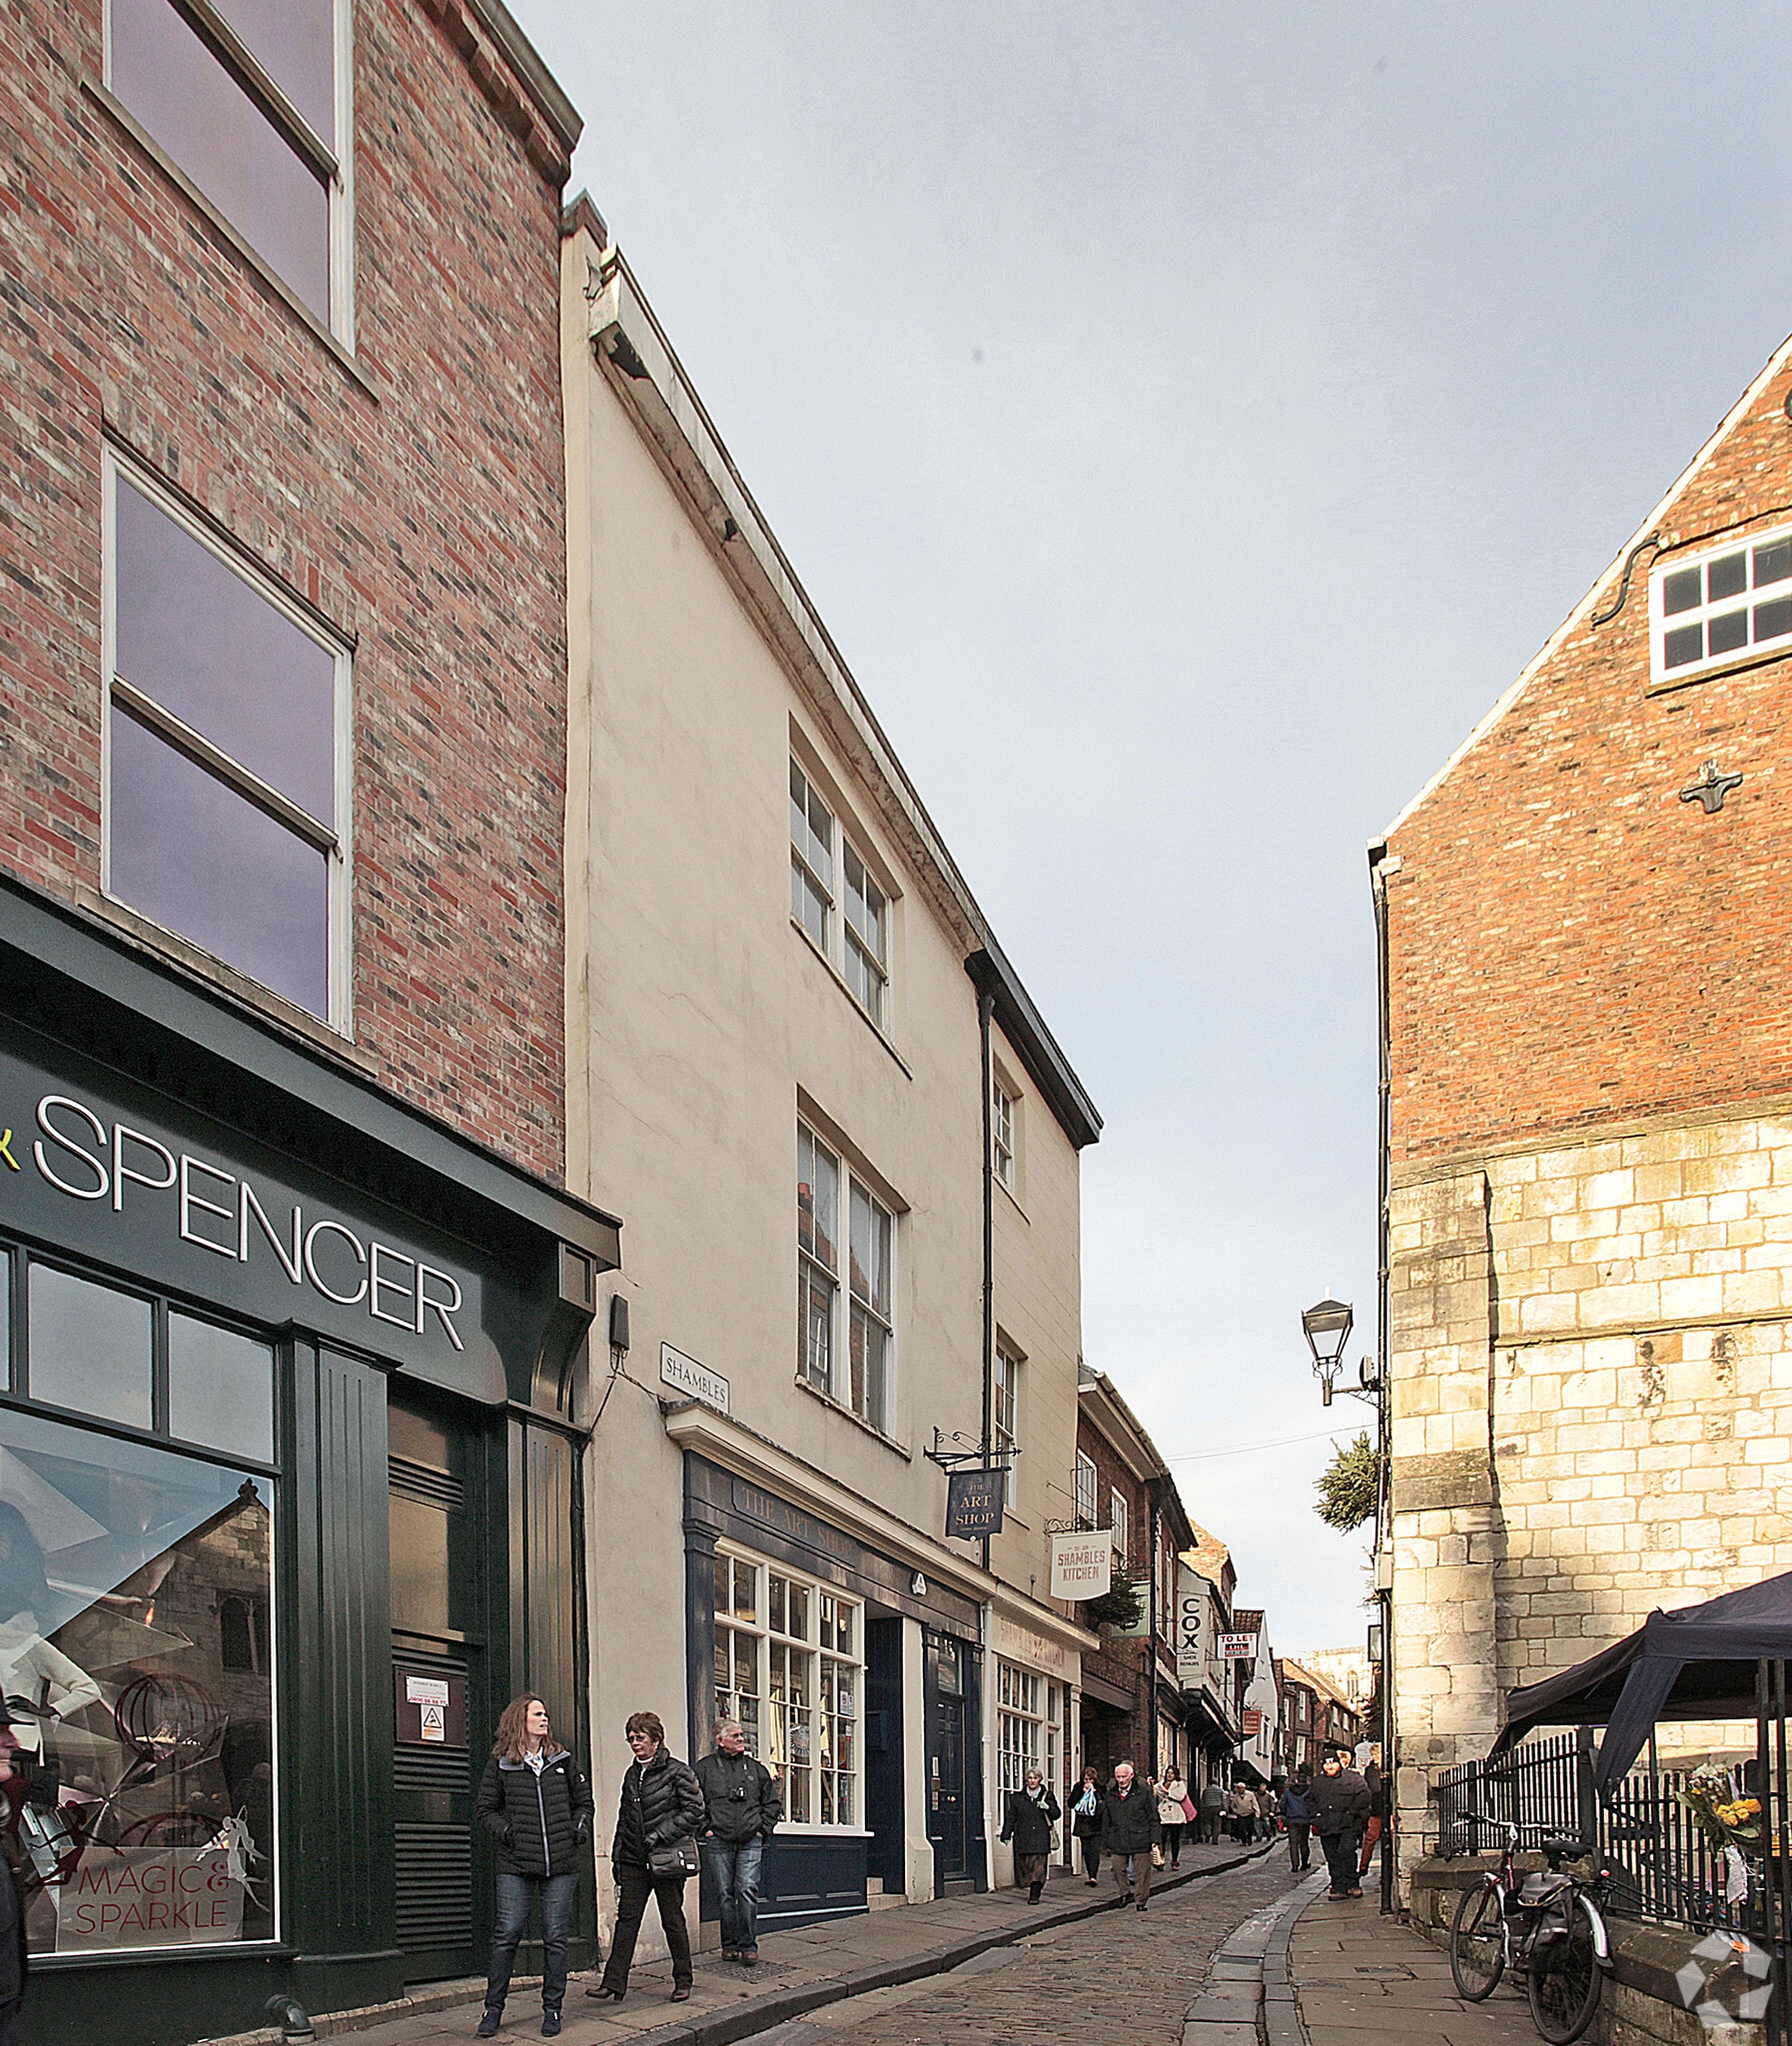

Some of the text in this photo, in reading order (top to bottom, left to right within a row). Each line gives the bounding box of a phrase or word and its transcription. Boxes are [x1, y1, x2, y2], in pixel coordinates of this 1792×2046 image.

[34, 1094, 464, 1351] SPENCER
[665, 1357, 725, 1403] SHAMBLES
[742, 1487, 774, 1522] THE
[783, 1510, 813, 1538] ART
[955, 1513, 995, 1526] SHOP
[960, 1495, 992, 1509] ART
[1058, 1550, 1106, 1566] SHAMBLES
[1063, 1566, 1100, 1581] KITCHEN
[1181, 1598, 1201, 1649] COX
[78, 1860, 230, 1895] MAGIC &
[75, 1899, 229, 1934] SPARKLE
